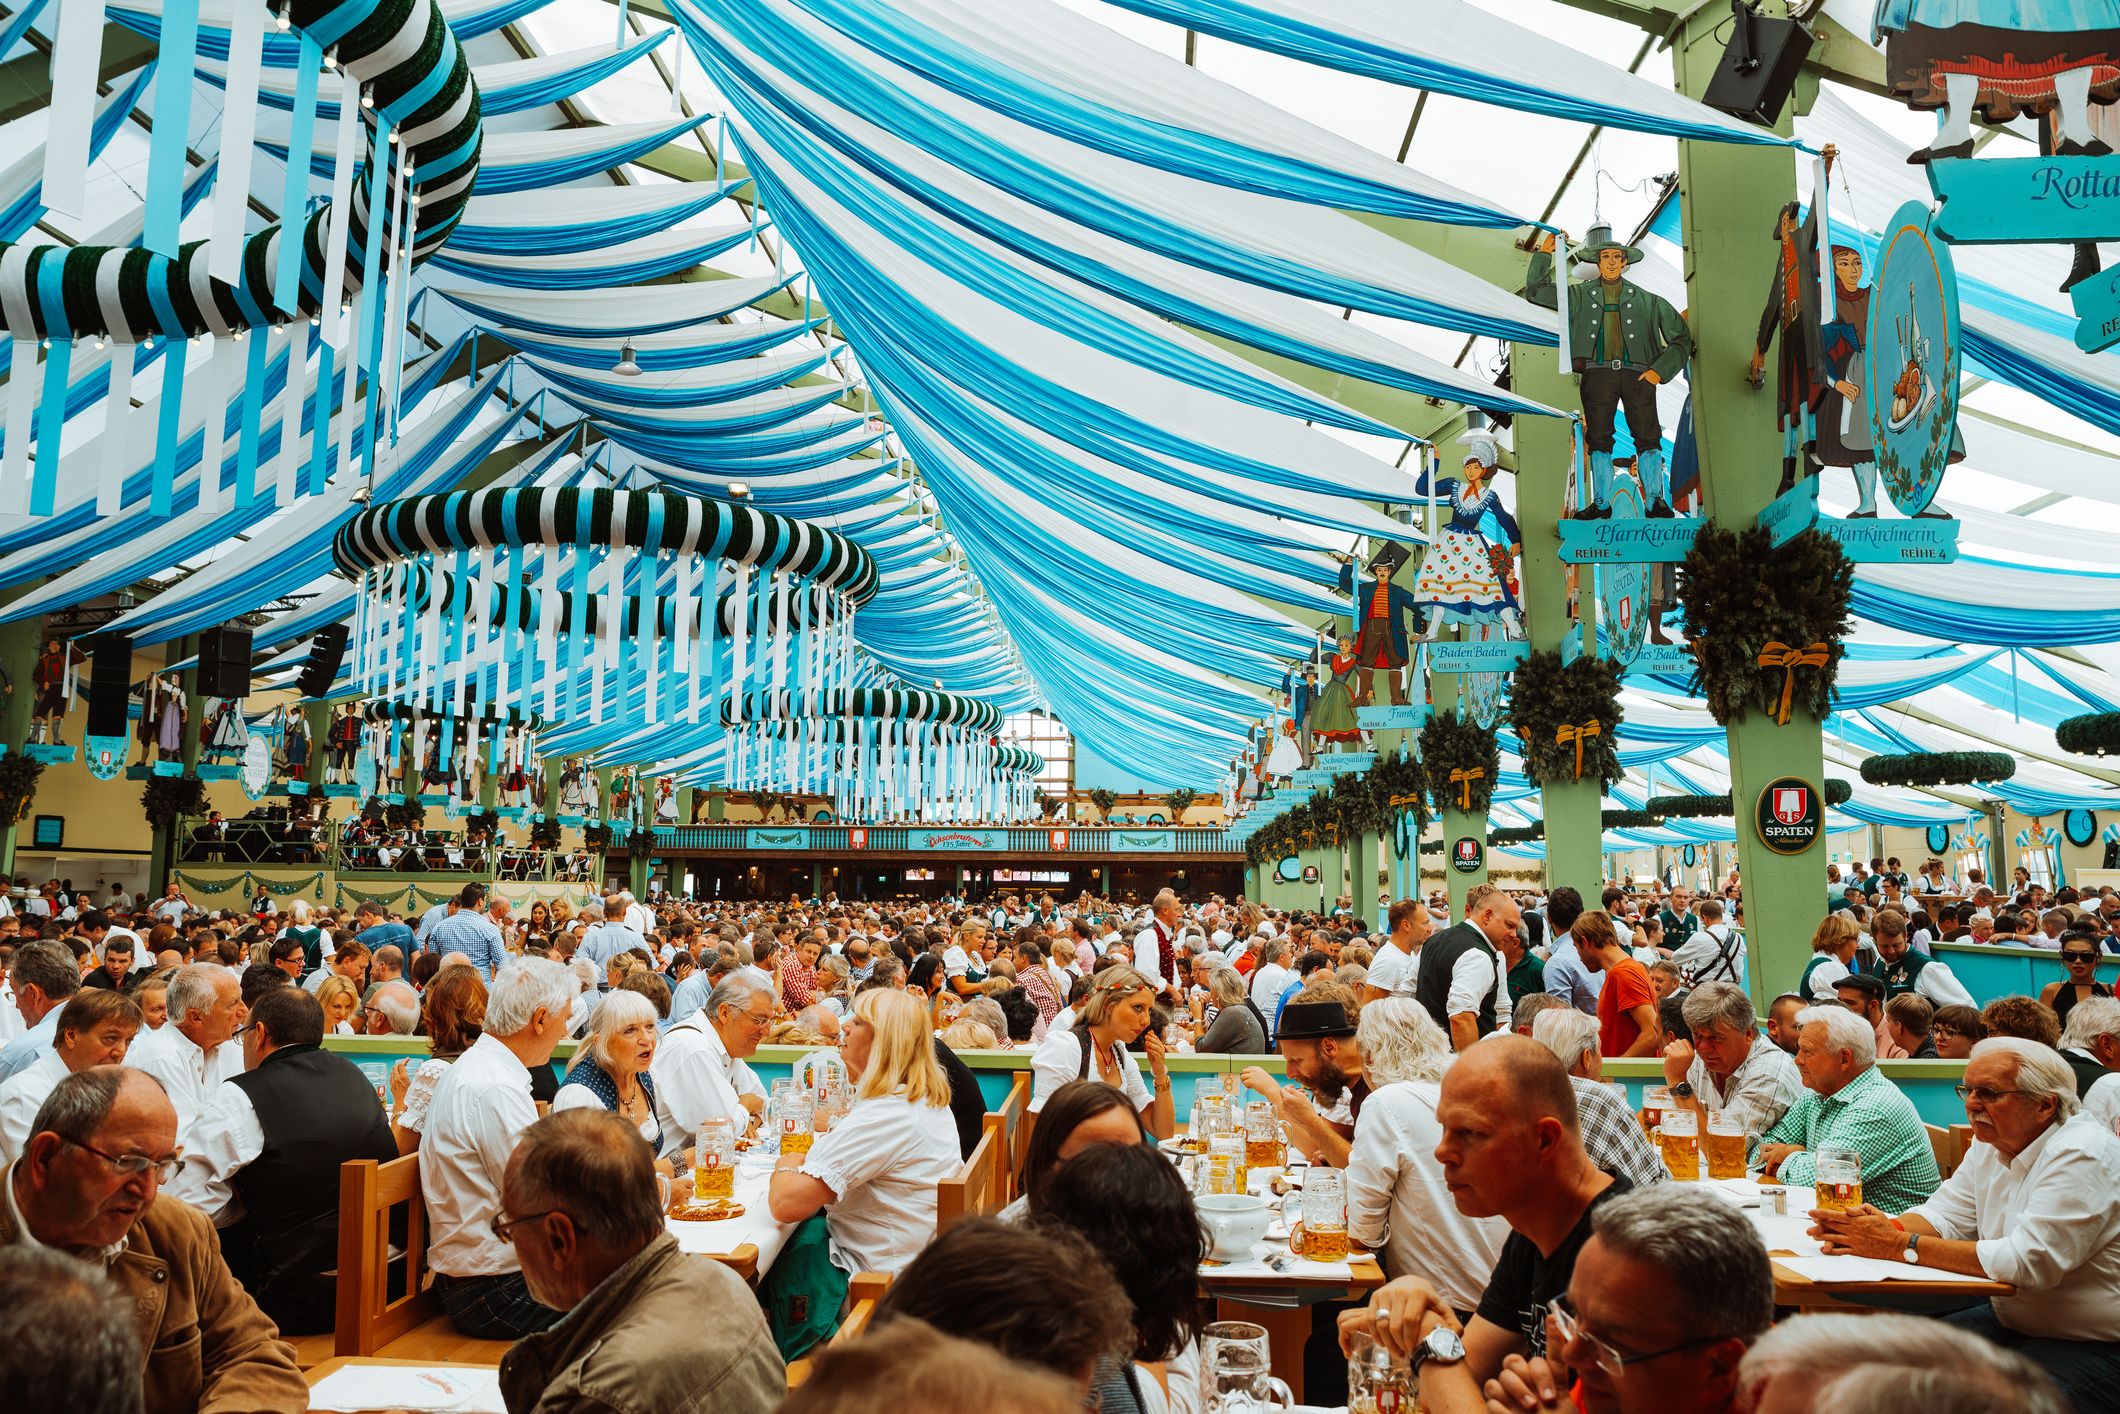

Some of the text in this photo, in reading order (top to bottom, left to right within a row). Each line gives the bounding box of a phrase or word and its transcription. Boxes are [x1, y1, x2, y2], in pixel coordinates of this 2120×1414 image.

[1614, 548, 1622, 558] 4
[1939, 548, 1946, 559] 4
[1765, 826, 1814, 836] SPATEN
